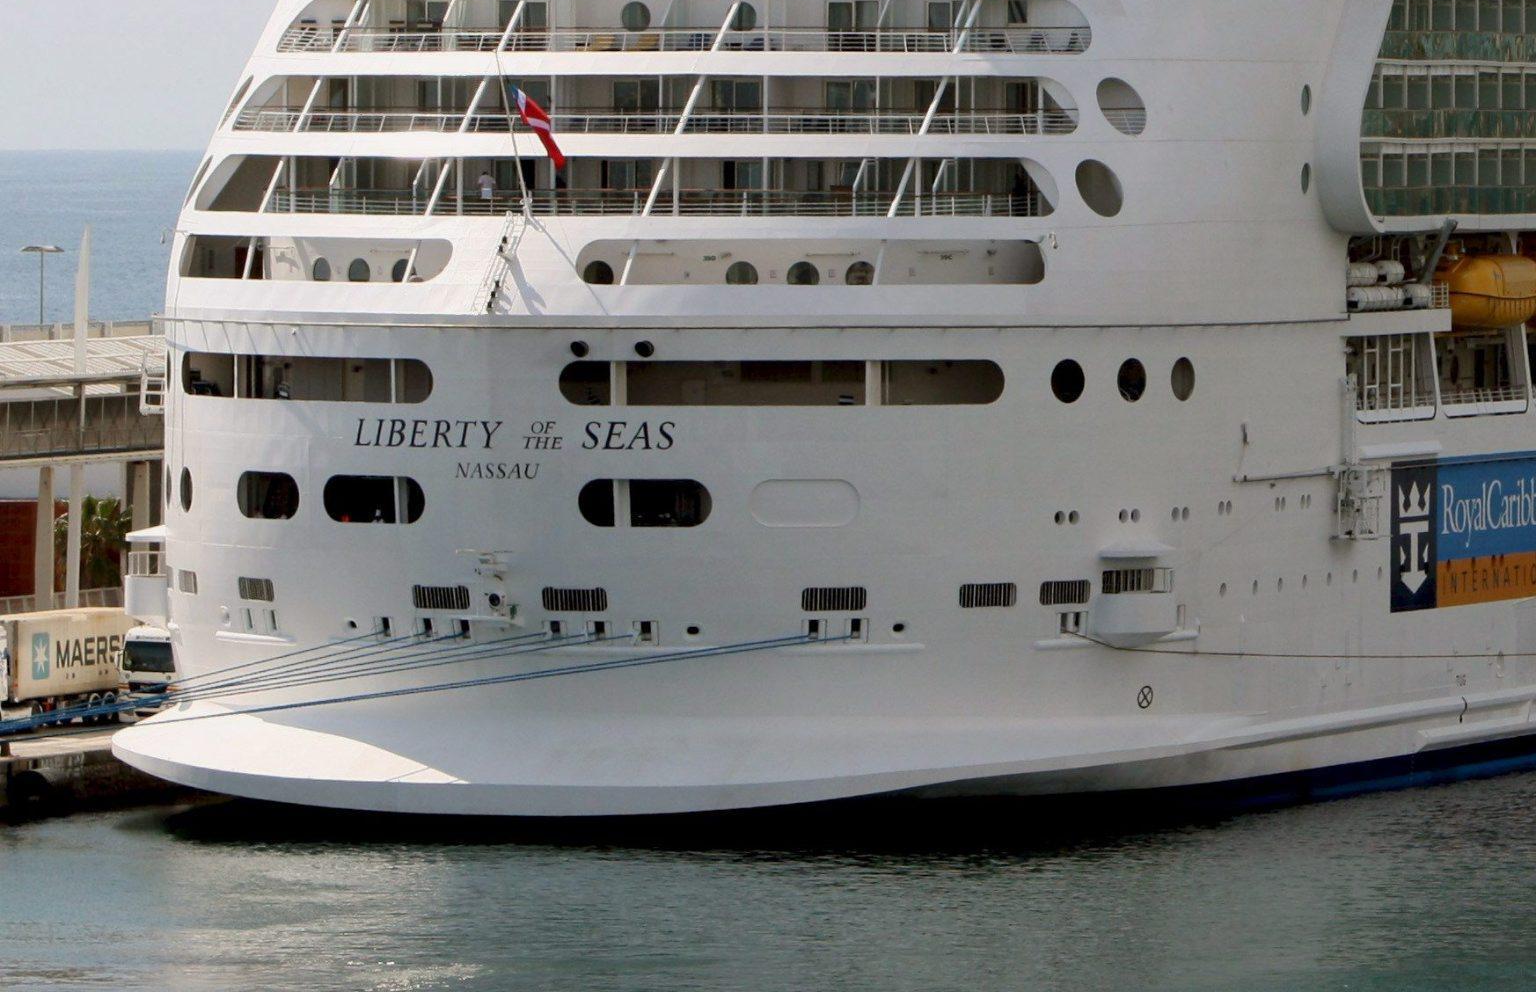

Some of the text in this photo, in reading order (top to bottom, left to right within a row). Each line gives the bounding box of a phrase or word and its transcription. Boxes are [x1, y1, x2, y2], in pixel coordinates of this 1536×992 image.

[353, 418, 676, 450] LIBERTY OF THE SEAS
[455, 462, 540, 480] NASSAU
